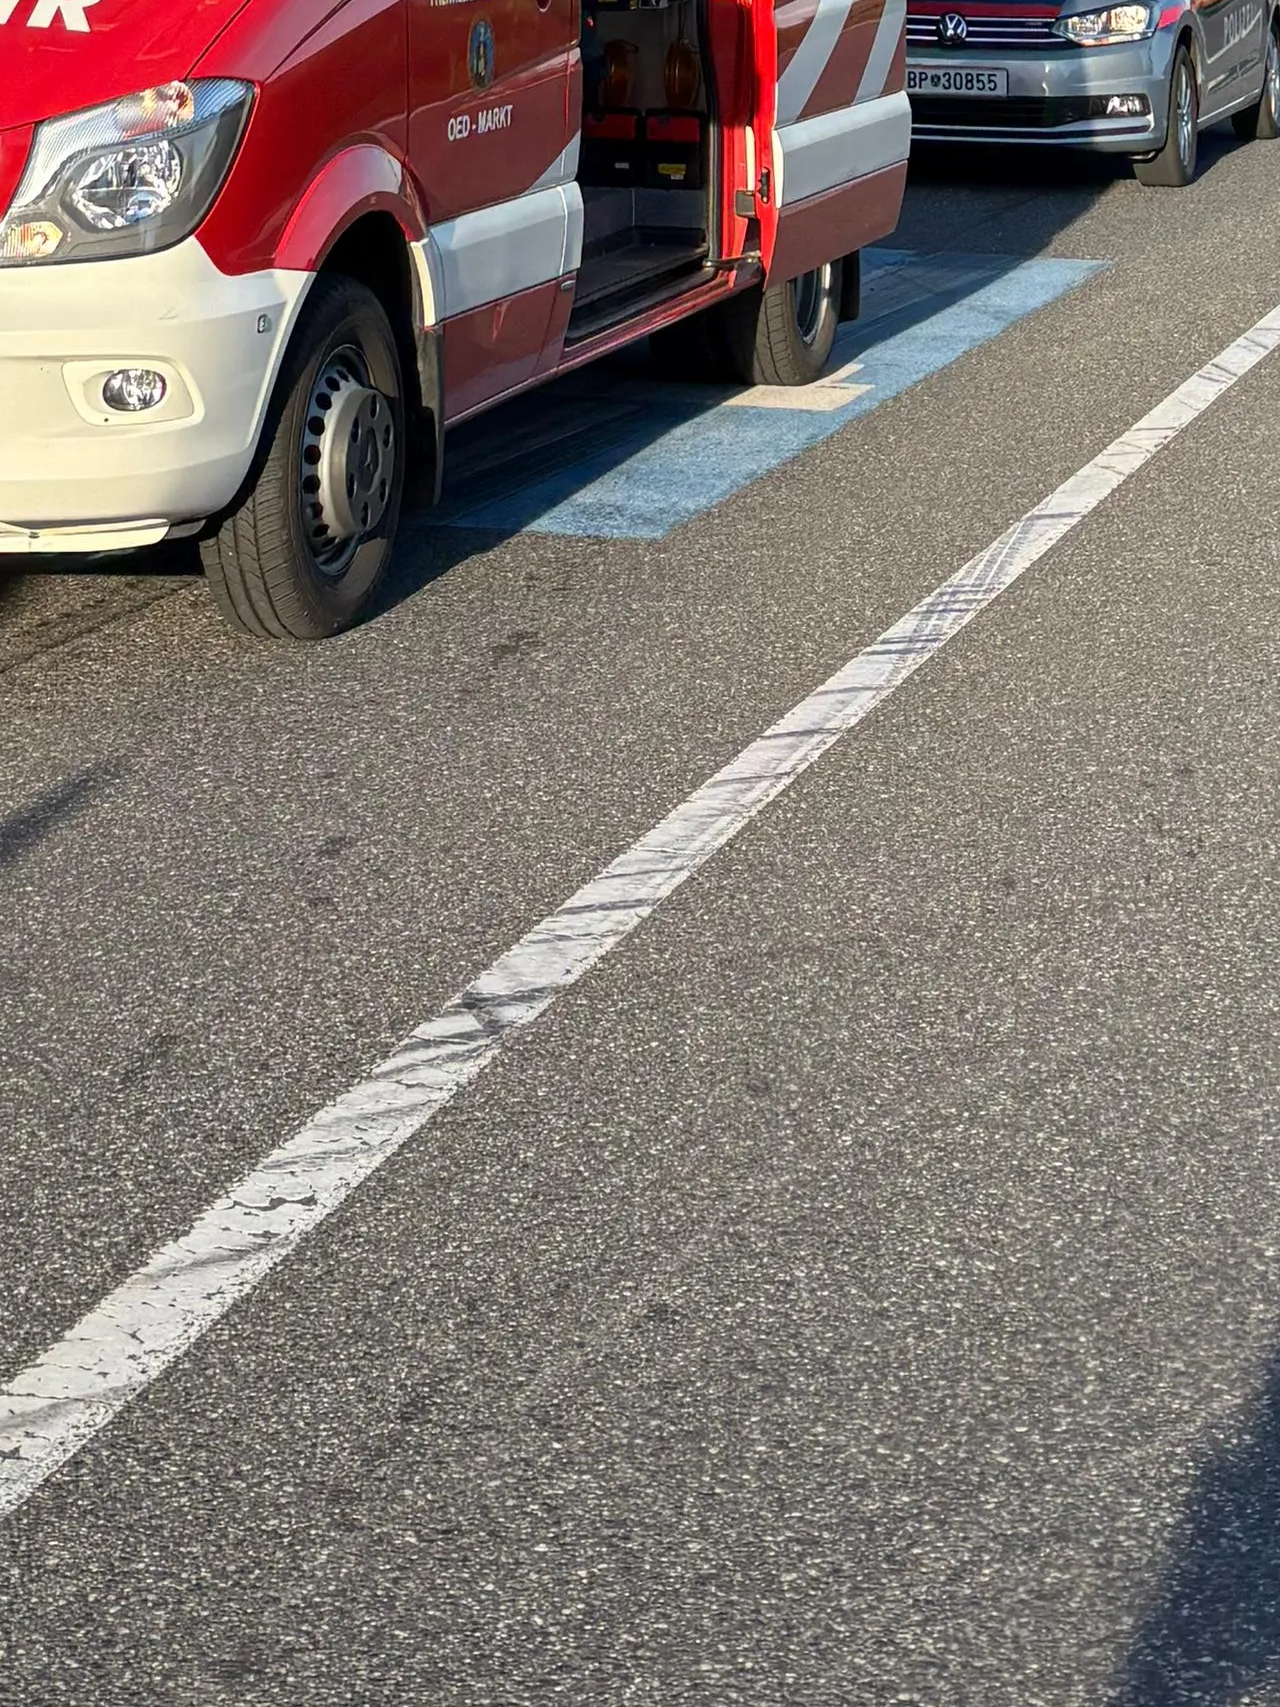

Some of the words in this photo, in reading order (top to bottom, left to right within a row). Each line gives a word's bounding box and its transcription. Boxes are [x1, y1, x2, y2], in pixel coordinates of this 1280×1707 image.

[942, 71, 998, 92] 30855
[447, 115, 470, 142] OED
[477, 104, 514, 135] MARKT
